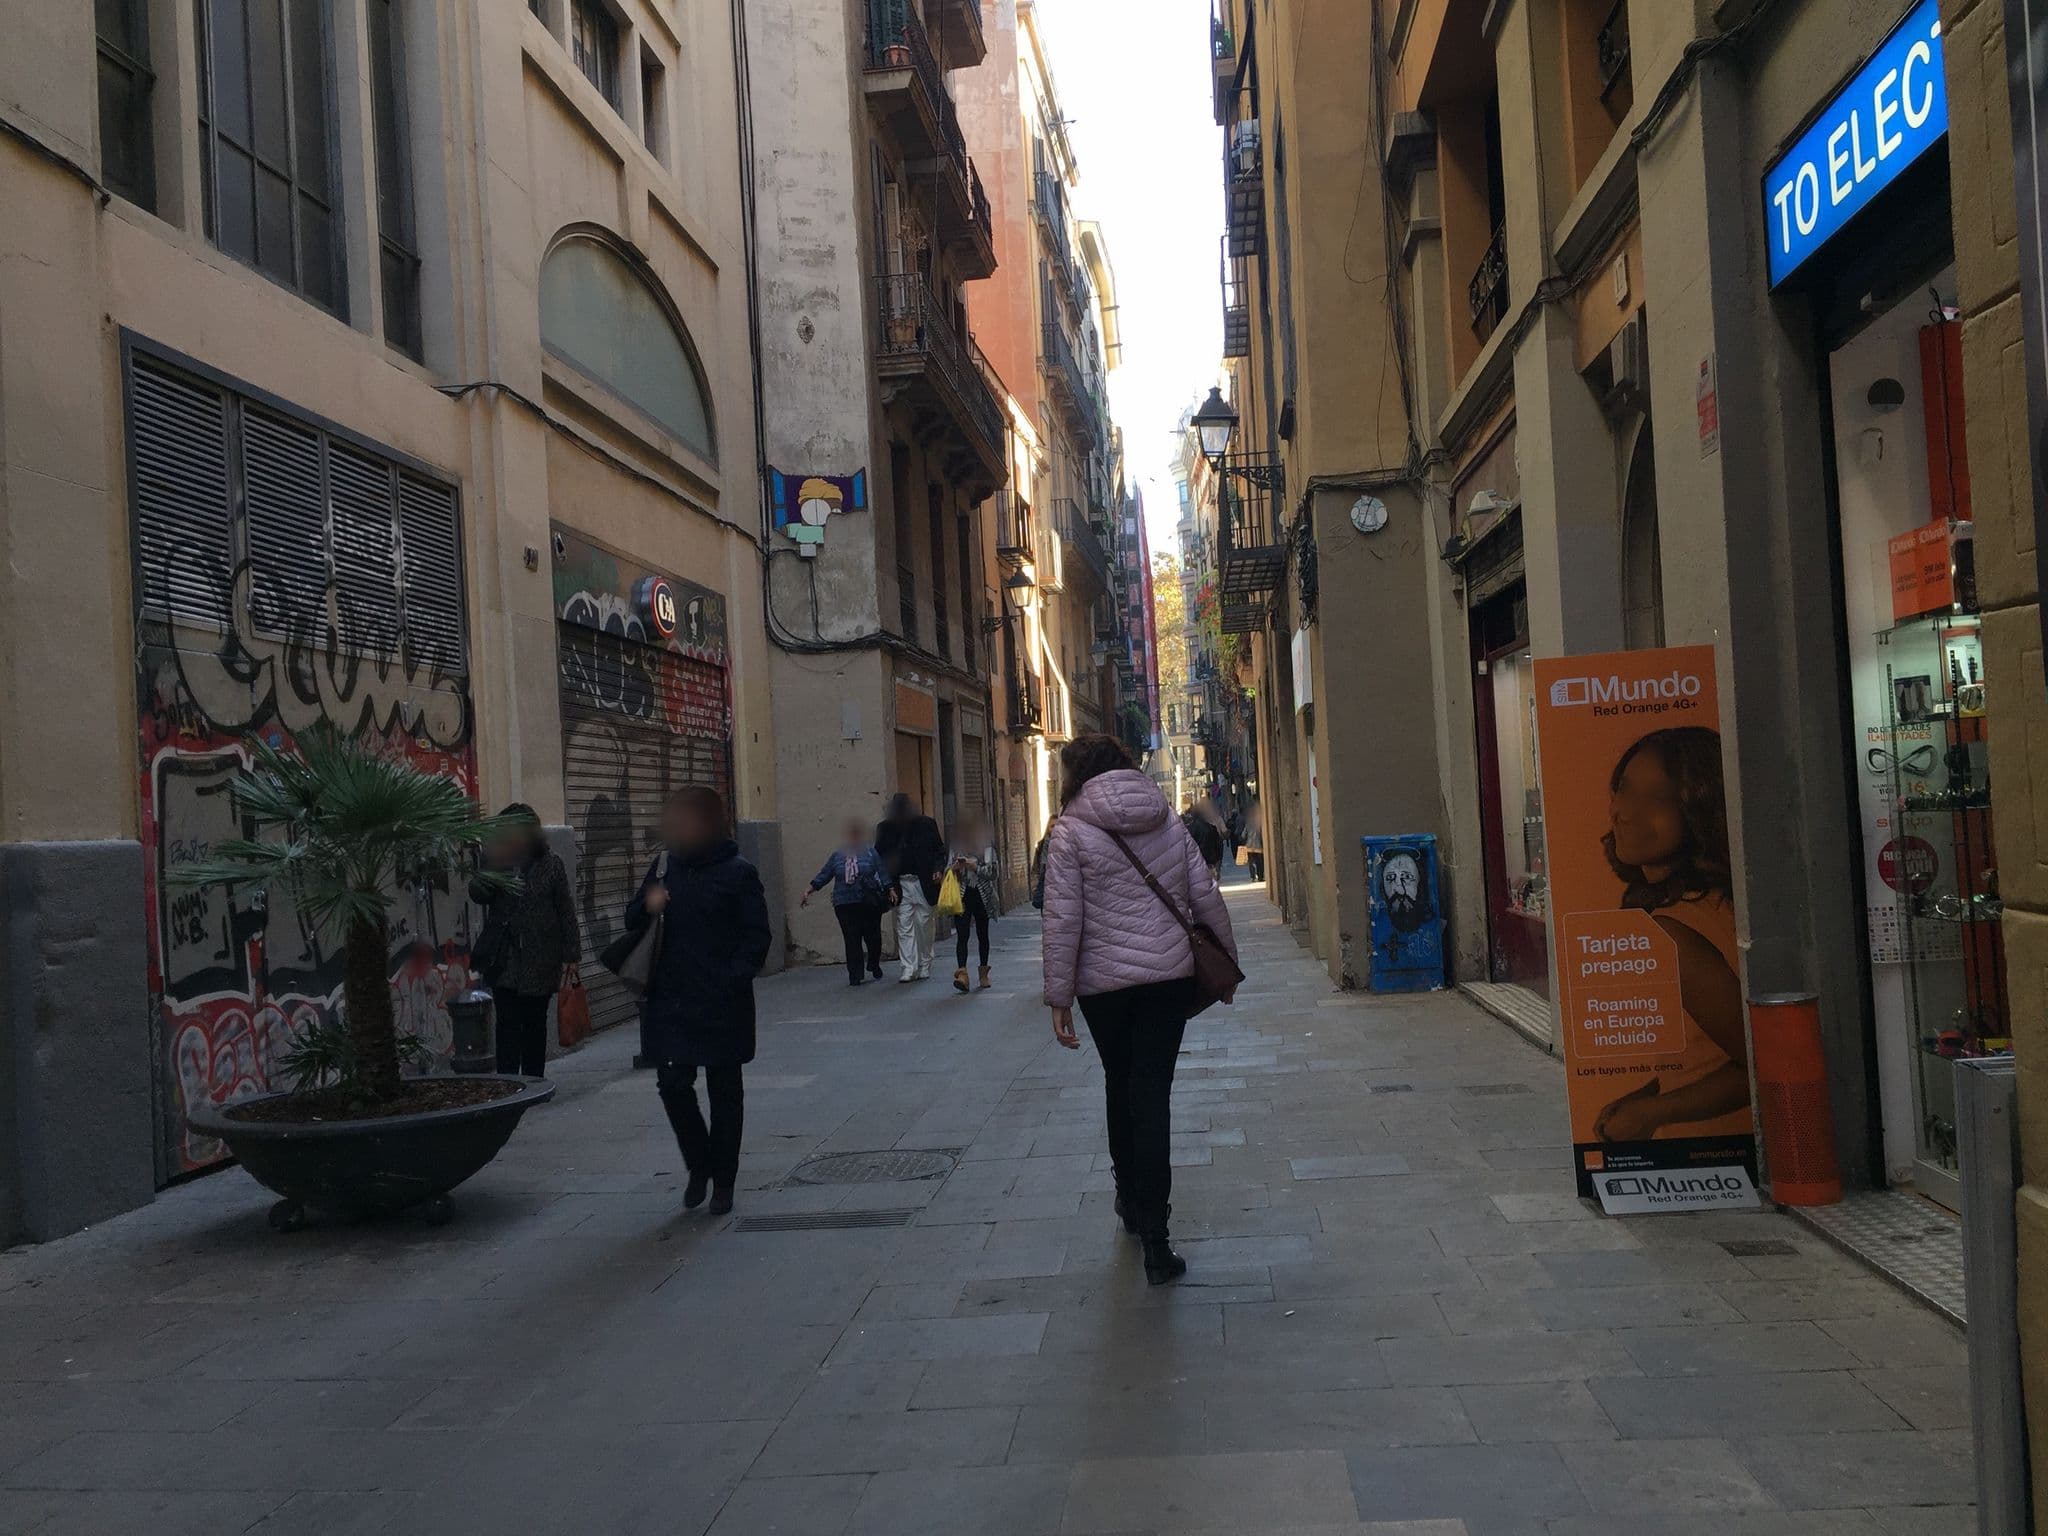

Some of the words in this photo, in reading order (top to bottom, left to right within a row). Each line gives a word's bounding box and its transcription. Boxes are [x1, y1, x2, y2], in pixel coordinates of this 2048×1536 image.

[1774, 162, 1819, 253] TO
[1828, 20, 1941, 207] ELEC
[1591, 670, 1702, 703] Mundo
[1593, 704, 1619, 717] Red
[1622, 702, 1670, 714] Orange
[1672, 699, 1699, 710] 4G+
[1577, 933, 1651, 956] Tarjeta
[1581, 958, 1658, 978] prepago
[1587, 996, 1659, 1012] Roaming
[1583, 1018, 1604, 1030] en
[1607, 1014, 1665, 1029] Europa
[1594, 1030, 1657, 1046] incluido
[1577, 1067, 1596, 1076] Los
[1599, 1065, 1627, 1077] tuyos
[1654, 1062, 1684, 1072] cerca
[1641, 1174, 1743, 1194] Mundo
[1647, 1195, 1672, 1203] Red
[1674, 1194, 1717, 1203] Orange
[1719, 1191, 1744, 1200] 4G+
